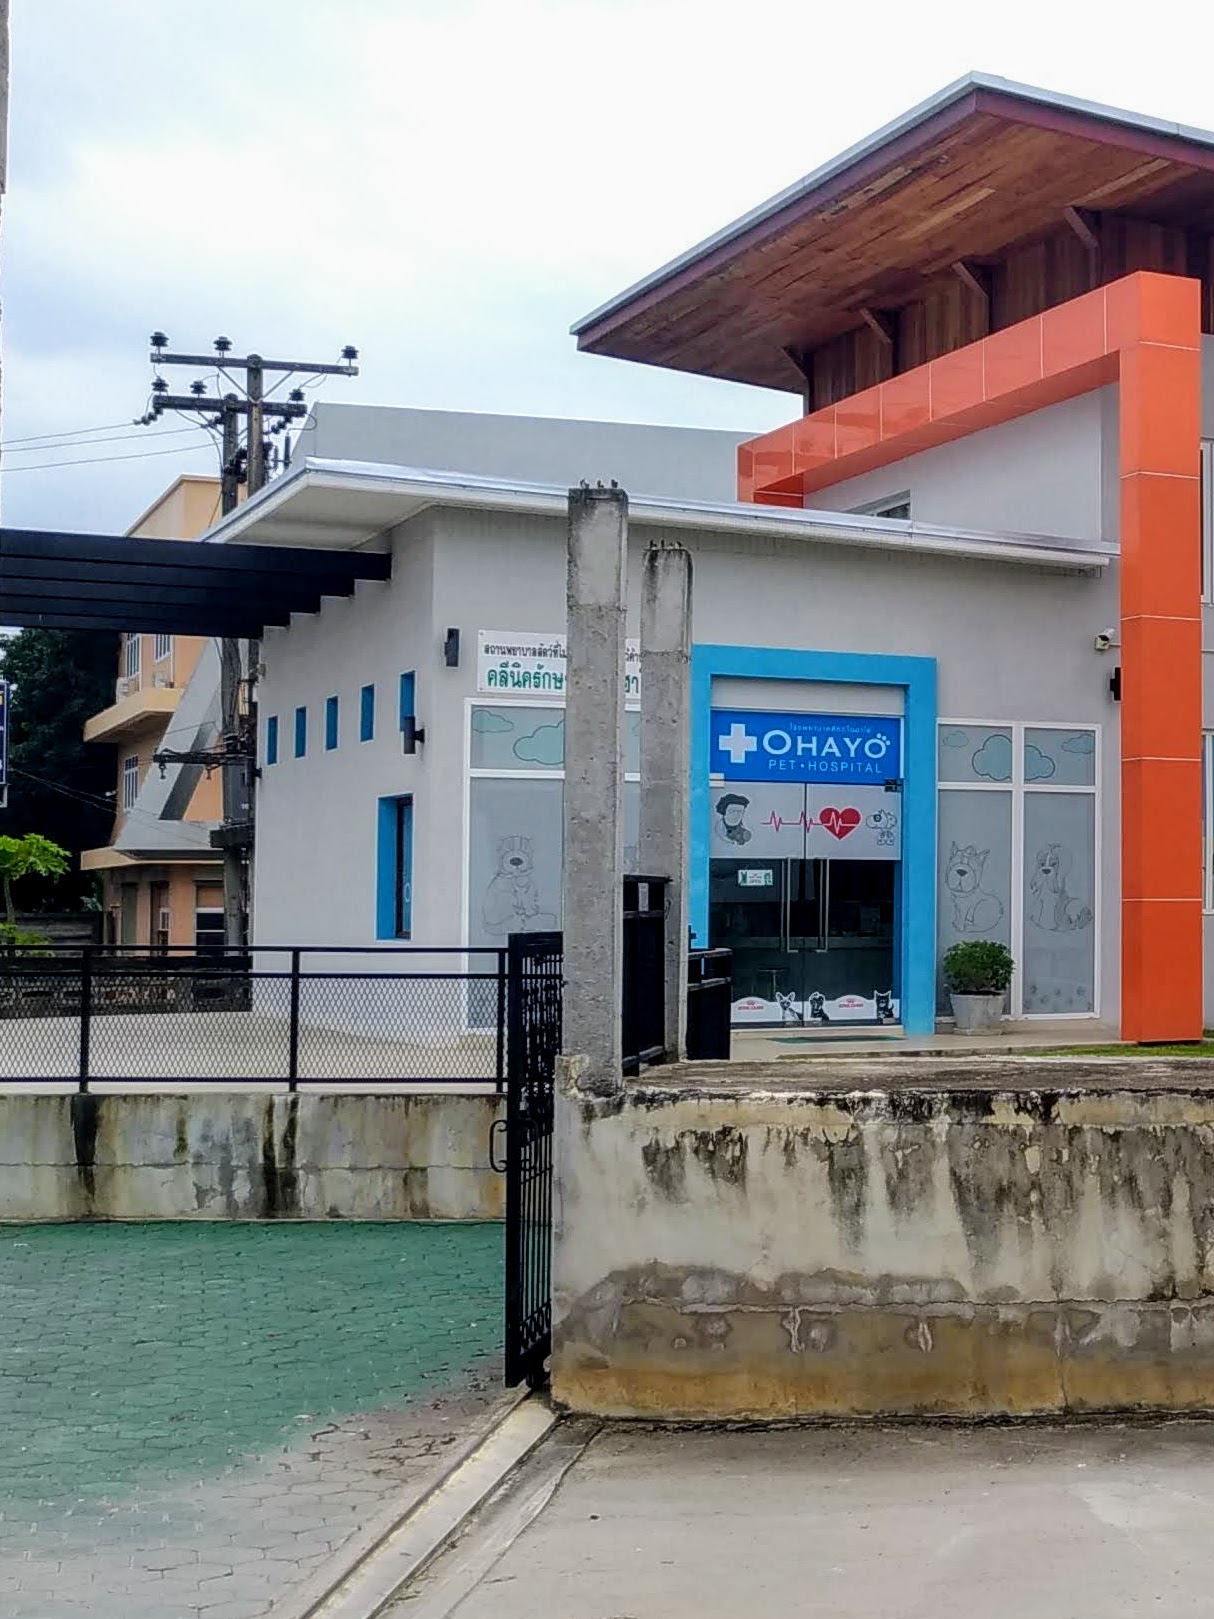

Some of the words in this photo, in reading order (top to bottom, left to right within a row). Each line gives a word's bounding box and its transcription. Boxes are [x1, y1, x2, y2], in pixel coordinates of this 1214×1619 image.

[762, 729, 890, 759] OHAYO
[768, 759, 797, 771] PET
[807, 760, 883, 774] HOSPITAL
